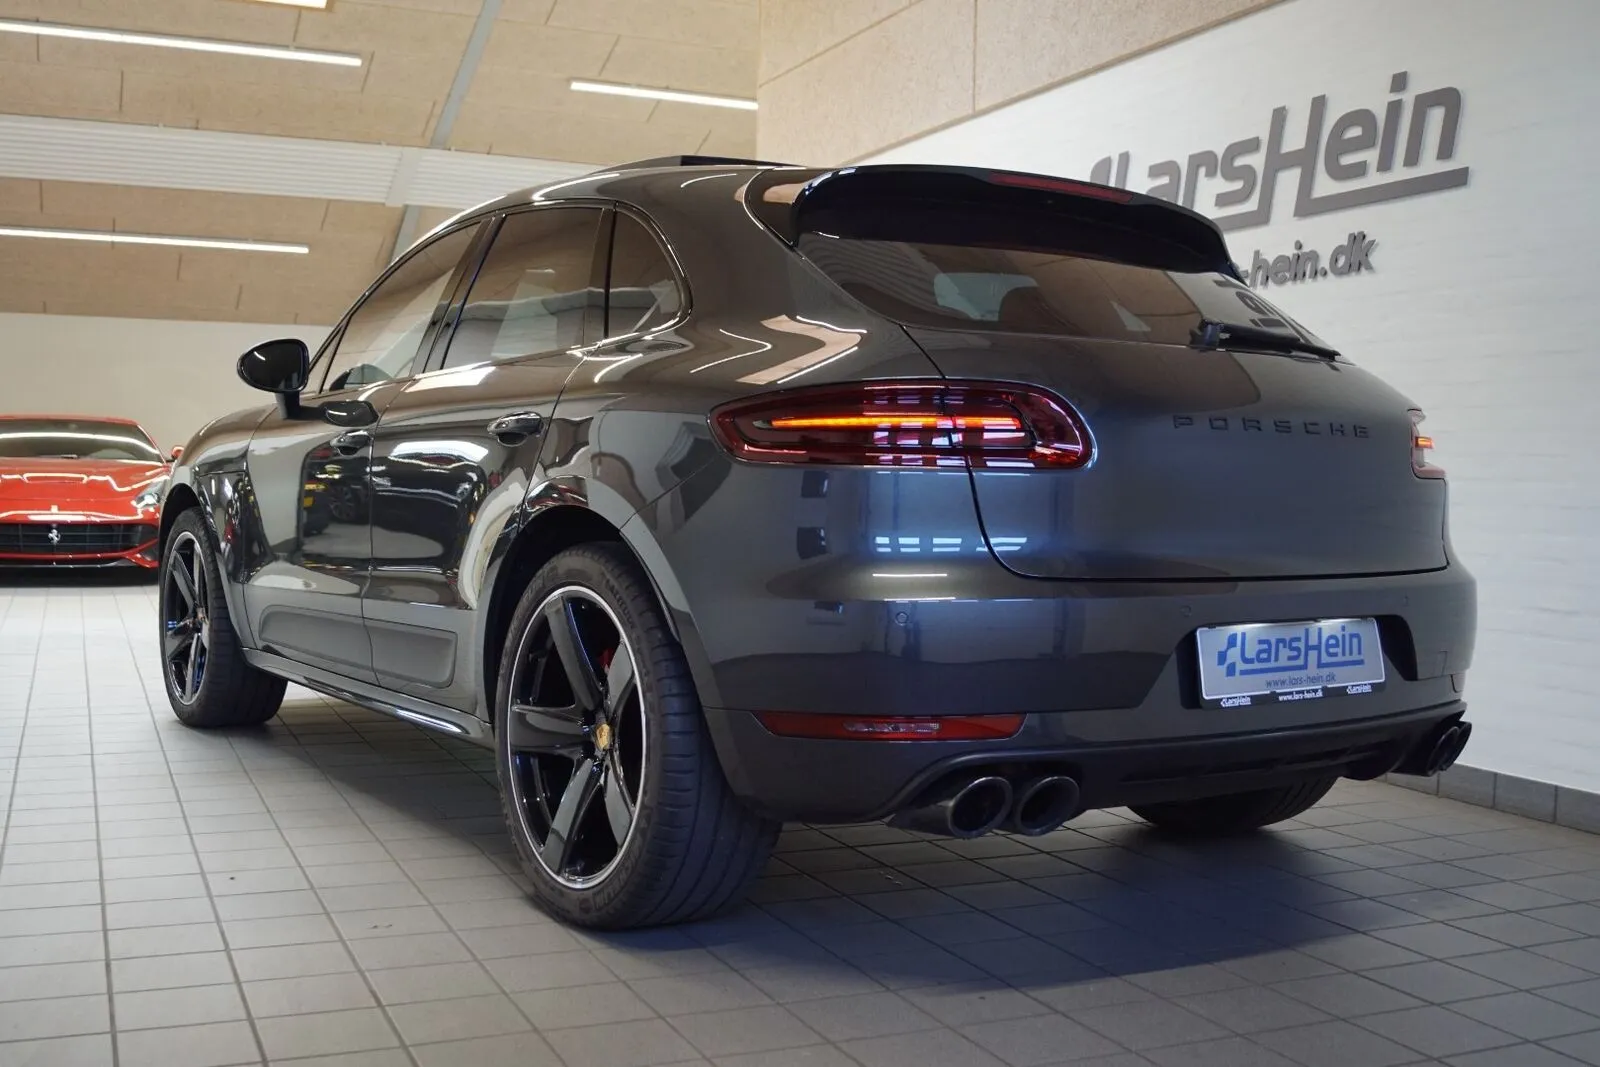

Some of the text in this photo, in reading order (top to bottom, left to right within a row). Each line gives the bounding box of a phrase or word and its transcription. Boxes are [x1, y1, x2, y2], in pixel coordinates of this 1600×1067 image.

[1173, 415, 1370, 439] PORSCHE
[1240, 625, 1362, 670] LarsHein
[1265, 671, 1336, 688] www.lars-hein.dk
